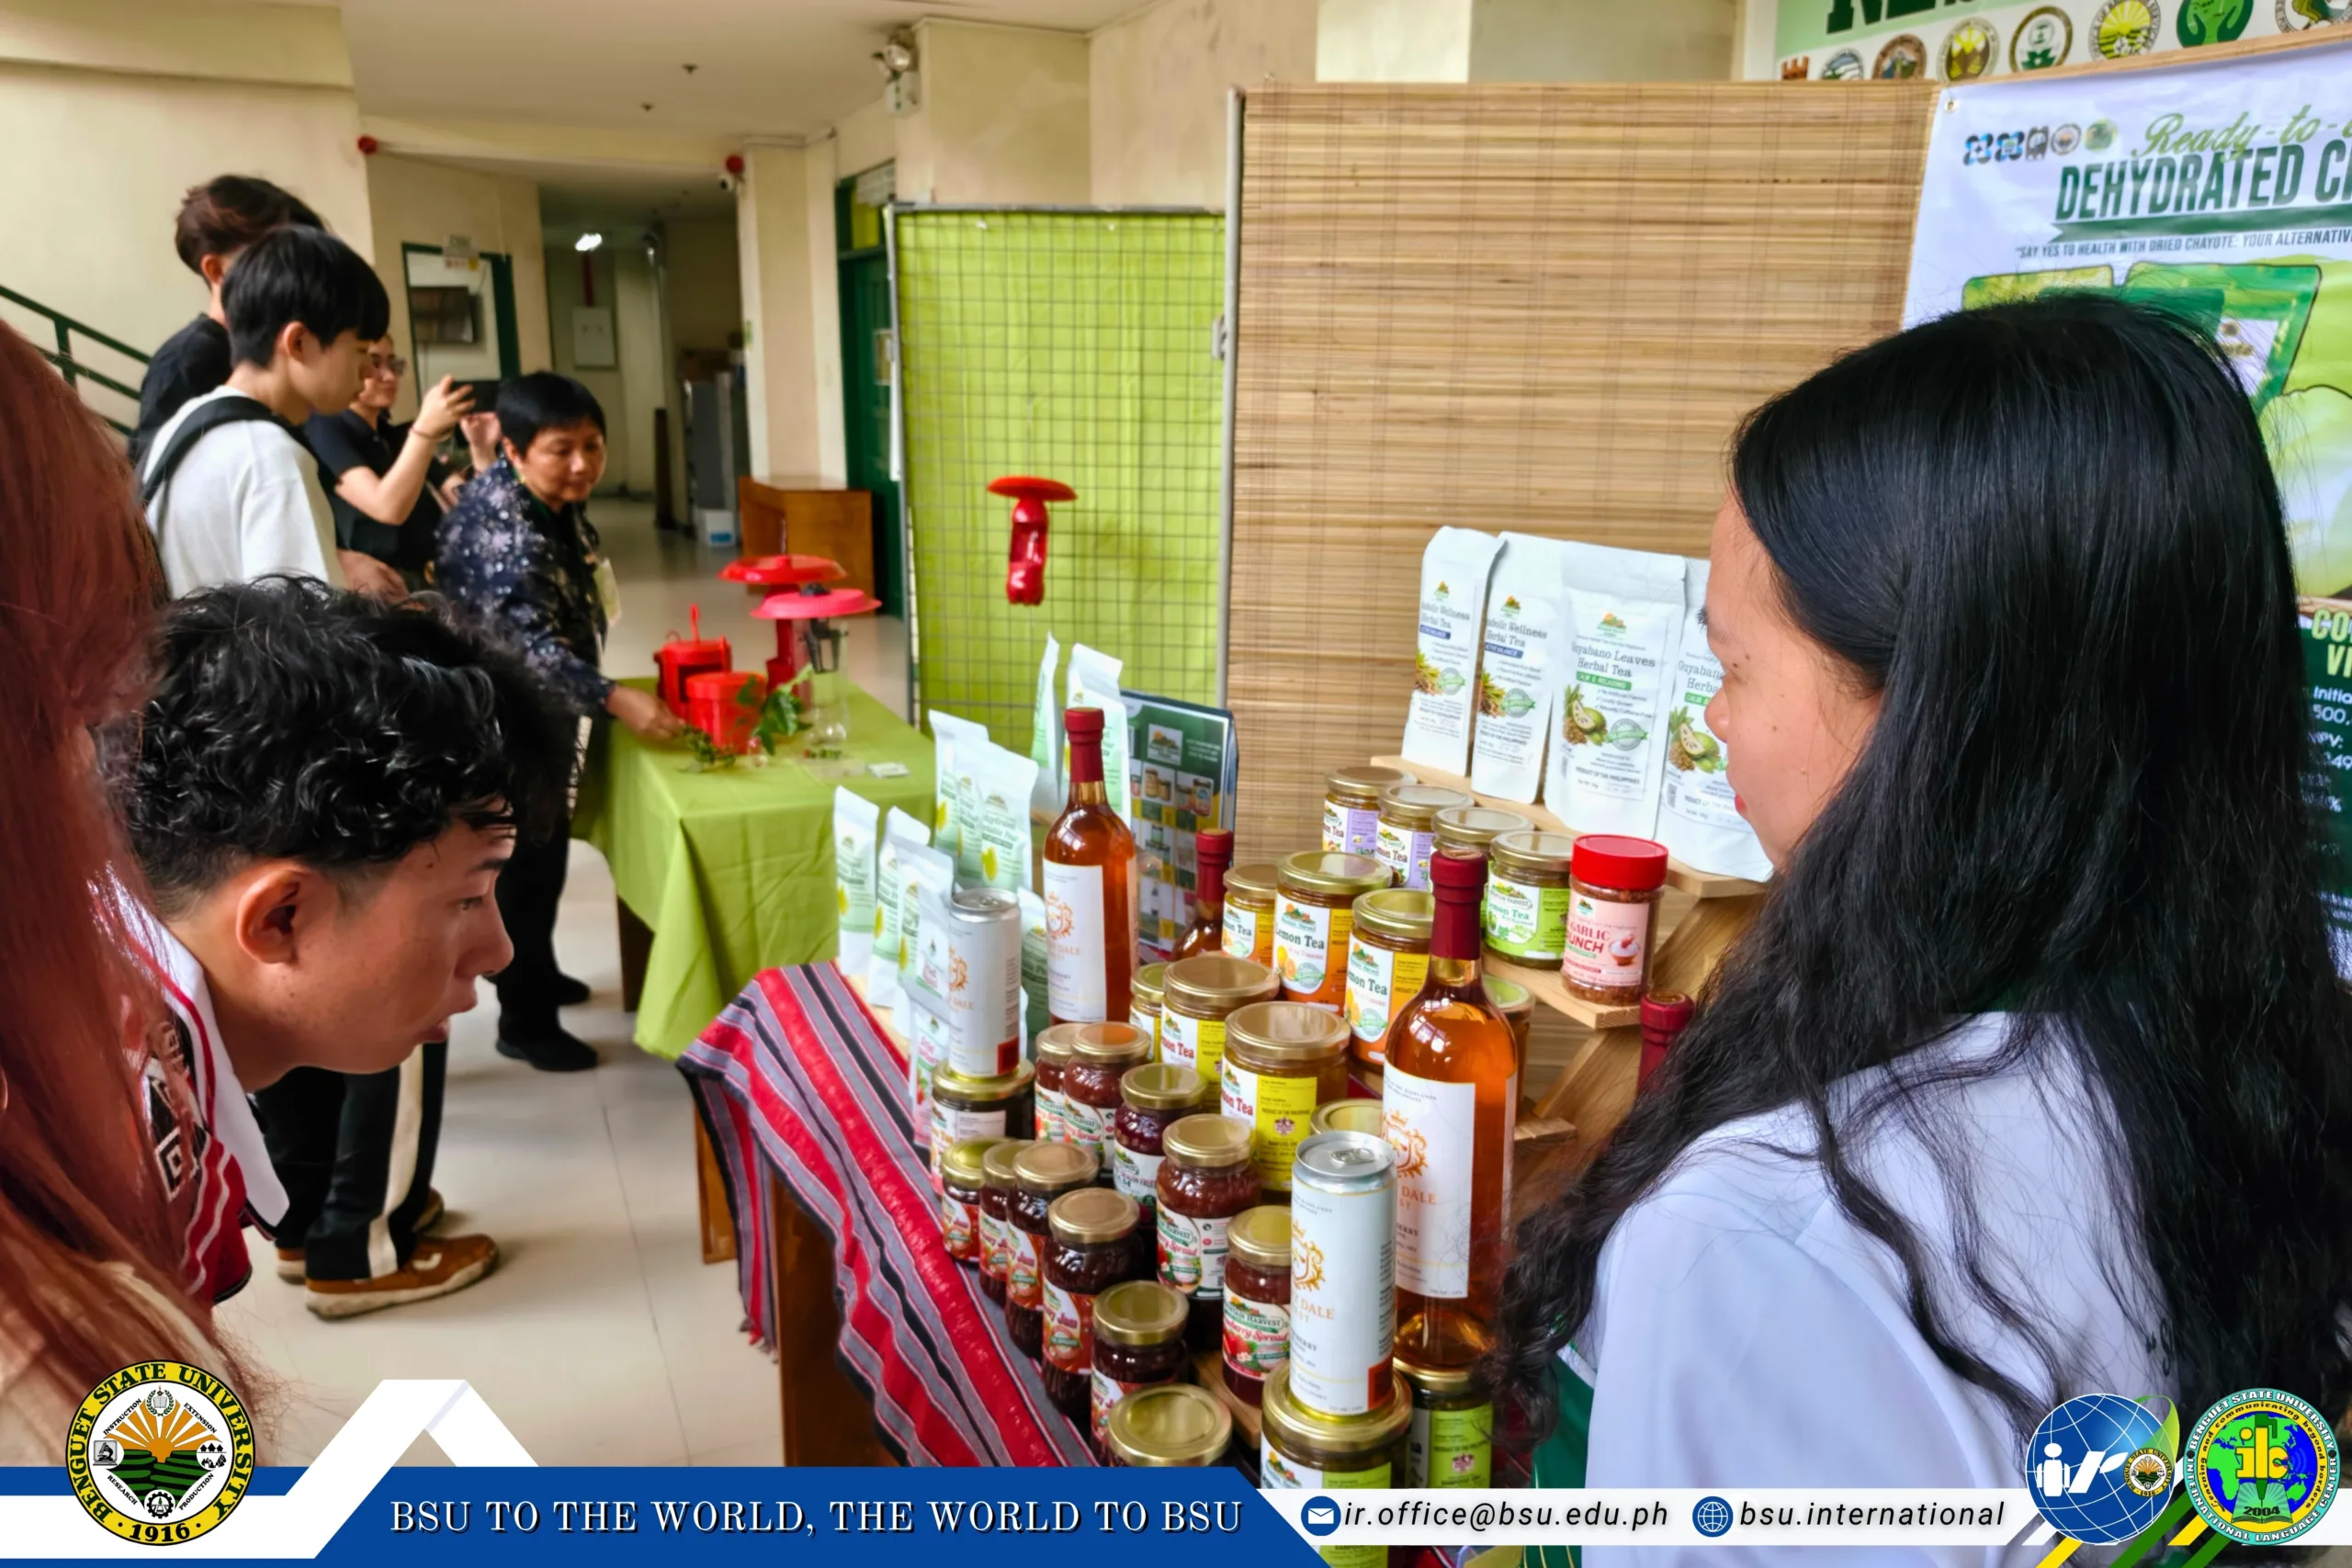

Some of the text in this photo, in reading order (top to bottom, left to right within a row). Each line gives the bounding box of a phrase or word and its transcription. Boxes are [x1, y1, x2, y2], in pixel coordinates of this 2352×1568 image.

[2055, 144, 2305, 220] DEHYDRATED
[2042, 244, 2060, 257] YES
[2063, 243, 2075, 256] TO
[2078, 242, 2115, 255] HEALTH
[2120, 239, 2146, 253] WITH
[2149, 238, 2182, 252] DRIED
[2243, 232, 2273, 247] YOUR
[2276, 228, 2352, 246] ALTERNATIV
[1508, 622, 1547, 639] Wellness
[2311, 609, 2352, 642] CO
[1509, 636, 1525, 648] Tea
[1614, 650, 1656, 667] Leaves
[1577, 658, 1632, 677] Herbal Tea
[1392, 849, 1408, 863] Tea
[1511, 908, 1529, 919] Tea
[1237, 925, 1252, 937] Tea
[1570, 921, 1610, 941] GARLIC
[1304, 935, 1325, 950] Tea
[1368, 978, 1388, 995] Tea
[1178, 1043, 1194, 1058] Tea
[1237, 1100, 1254, 1116] Tea
[1402, 1186, 1436, 1204] DALE
[1399, 1198, 1411, 1210] ST
[1170, 1241, 1198, 1257] Spread
[1301, 1299, 1334, 1320] DALE
[1247, 1314, 1281, 1326] HARVEST
[1253, 1330, 1290, 1343] Spread
